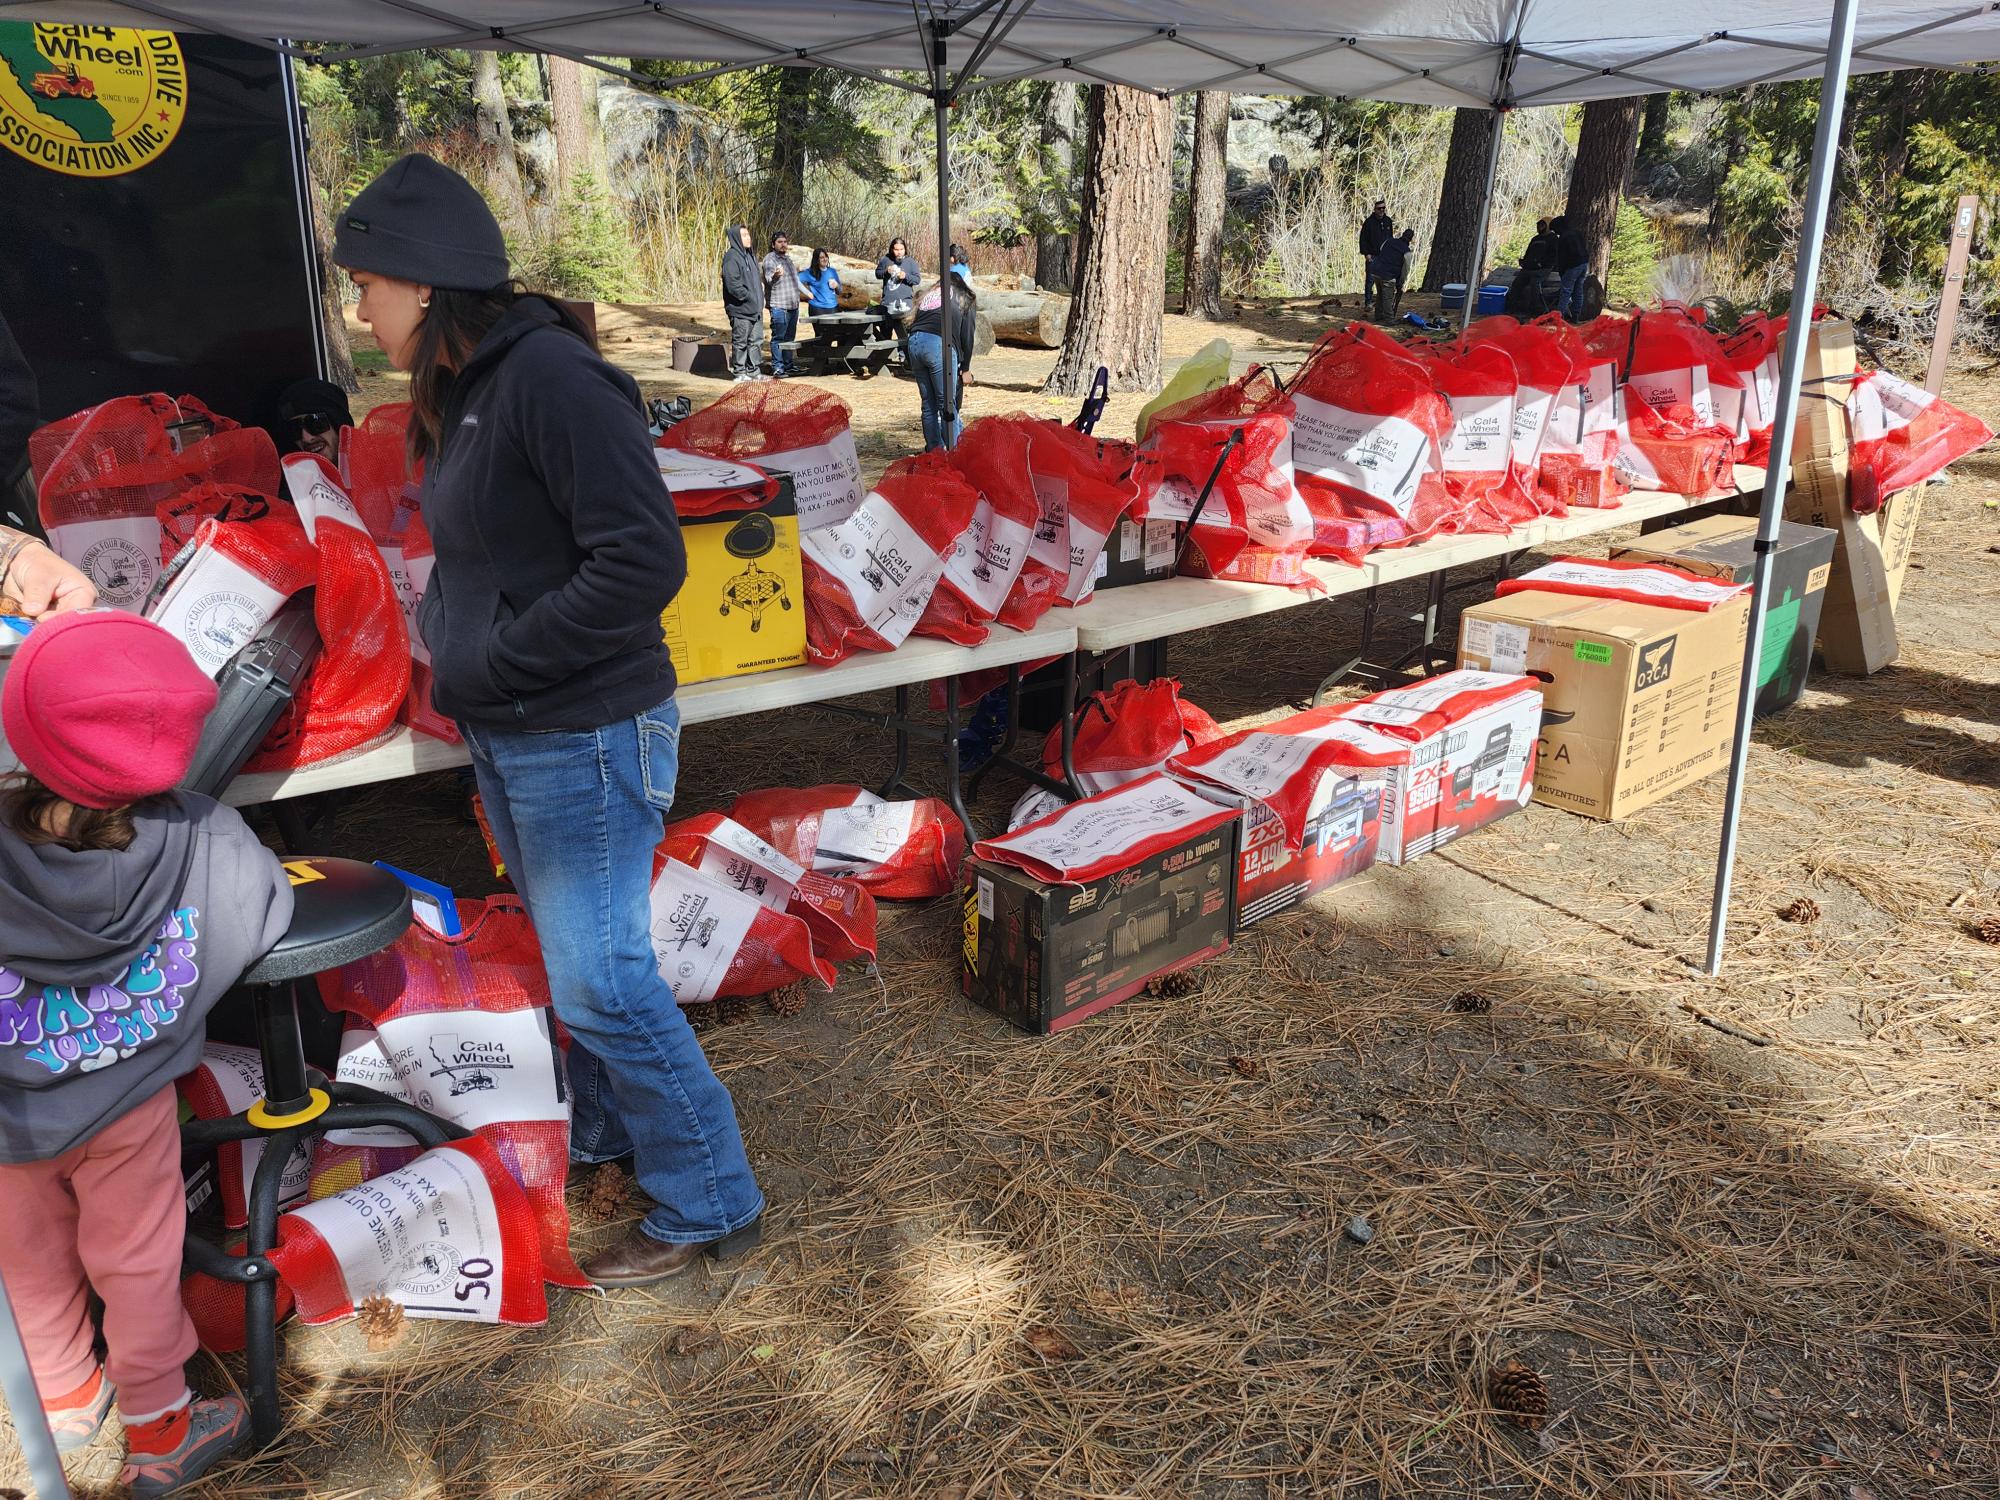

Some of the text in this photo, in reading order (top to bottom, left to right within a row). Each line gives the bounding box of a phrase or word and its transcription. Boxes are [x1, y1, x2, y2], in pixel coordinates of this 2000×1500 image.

[37, 35, 143, 68] Wheel
[114, 68, 144, 77] .com
[147, 35, 183, 108] DRIVE
[101, 93, 123, 103] SINCE
[131, 122, 170, 159] INC.
[1958, 207, 1971, 226] 5
[1649, 393, 1677, 402] Wheel
[1650, 387, 1675, 396] Cal4
[1294, 411, 1319, 425] PLEASE
[1319, 421, 1335, 431] TAKE
[1473, 417, 1498, 426] Cal4
[1516, 407, 1538, 419] Cal4
[1307, 425, 1324, 436] THAN
[1324, 431, 1337, 439] YOU
[1468, 425, 1500, 433] Wheel
[1369, 442, 1397, 459] Wheel
[1376, 435, 1399, 449] Cal4
[793, 467, 813, 479] TAKE
[813, 464, 830, 475] OUT
[809, 476, 826, 487] YOU
[807, 502, 821, 512] 4X4
[826, 496, 845, 508] FUNN
[817, 489, 832, 501] you
[970, 517, 986, 533] ORE
[888, 547, 913, 573] Cal4
[987, 549, 1012, 567] heel
[1069, 545, 1086, 556] al4
[879, 550, 908, 583] Wheel
[191, 595, 256, 622] CALIFORNIA FOUR
[1556, 640, 1575, 650] CARE
[736, 658, 777, 669] GUARANTEED
[1637, 662, 1669, 689] ORCA
[1536, 738, 1571, 764] CA
[1412, 759, 1449, 788] ZXR
[1619, 788, 1631, 801] FOR
[1632, 781, 1645, 795] ALL
[1674, 749, 1714, 774] ADVENTURES
[1408, 780, 1441, 809] 9500
[1536, 784, 1597, 807] ADVENTURES
[1194, 837, 1220, 857] WINCH
[669, 892, 692, 925] Cal4
[675, 894, 704, 934] Wheel
[24, 984, 185, 1074] YOU SMILE
[459, 1040, 505, 1053] Cal4
[344, 1046, 416, 1070] PLEASE ORE
[452, 1053, 512, 1065] Wheel
[337, 1067, 375, 1081] TRASH
[411, 1058, 423, 1072] IN
[385, 1175, 411, 1191] you
[416, 1176, 438, 1199] 4X4
[344, 1194, 374, 1217] OUT
[370, 1190, 397, 1219] YOU
[454, 1257, 494, 1301] 50
